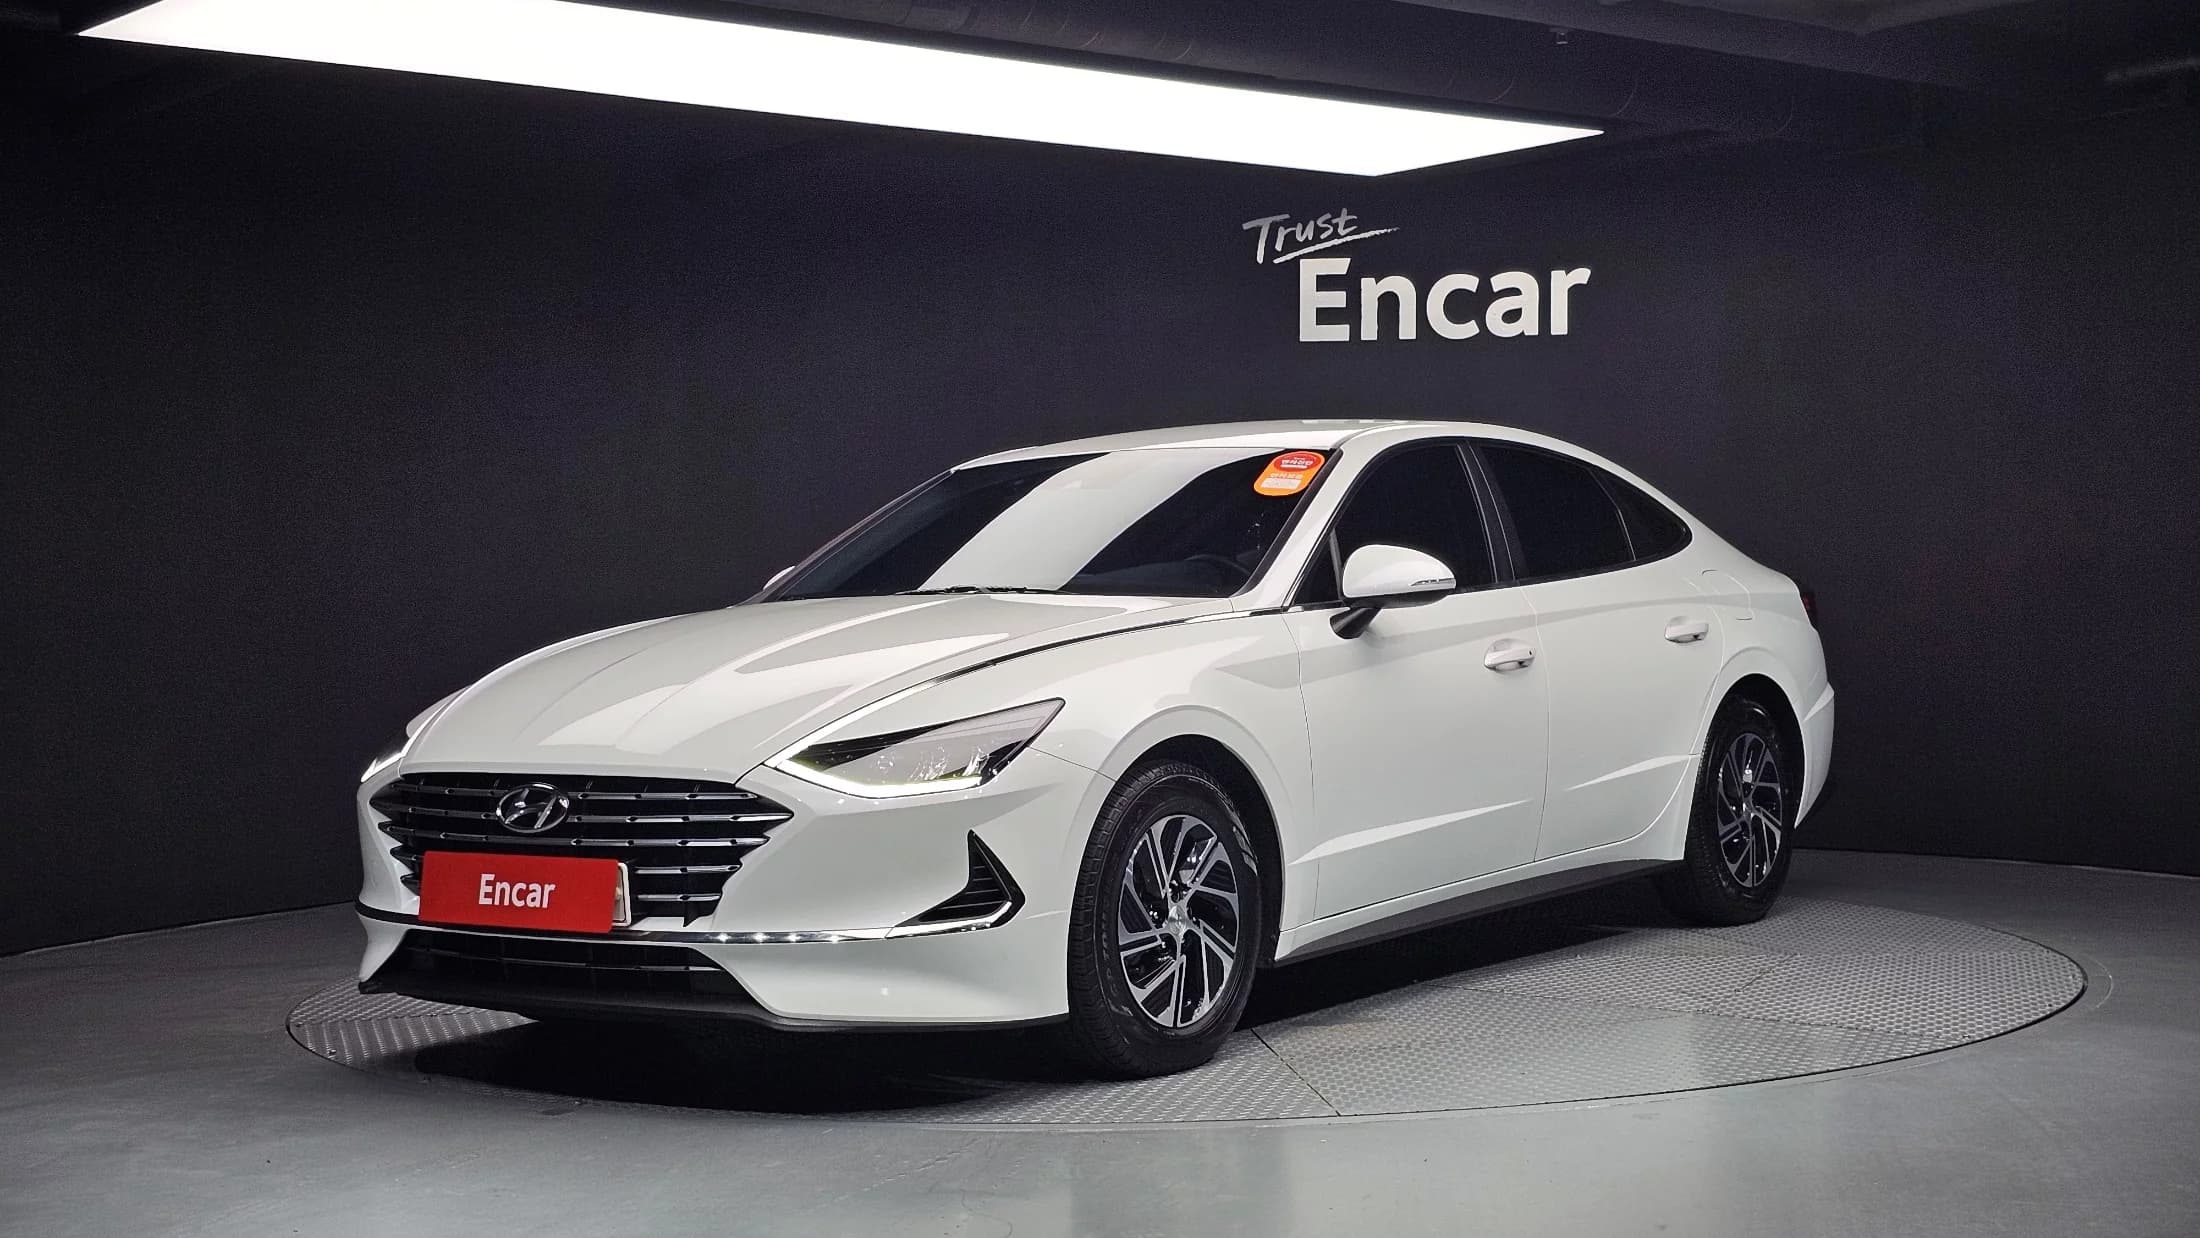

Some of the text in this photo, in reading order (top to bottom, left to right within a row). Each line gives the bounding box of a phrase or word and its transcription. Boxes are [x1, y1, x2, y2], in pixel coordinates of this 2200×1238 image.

[1242, 207, 1358, 264] Trust
[1299, 257, 1592, 342] Encar
[478, 873, 556, 909] Encar
